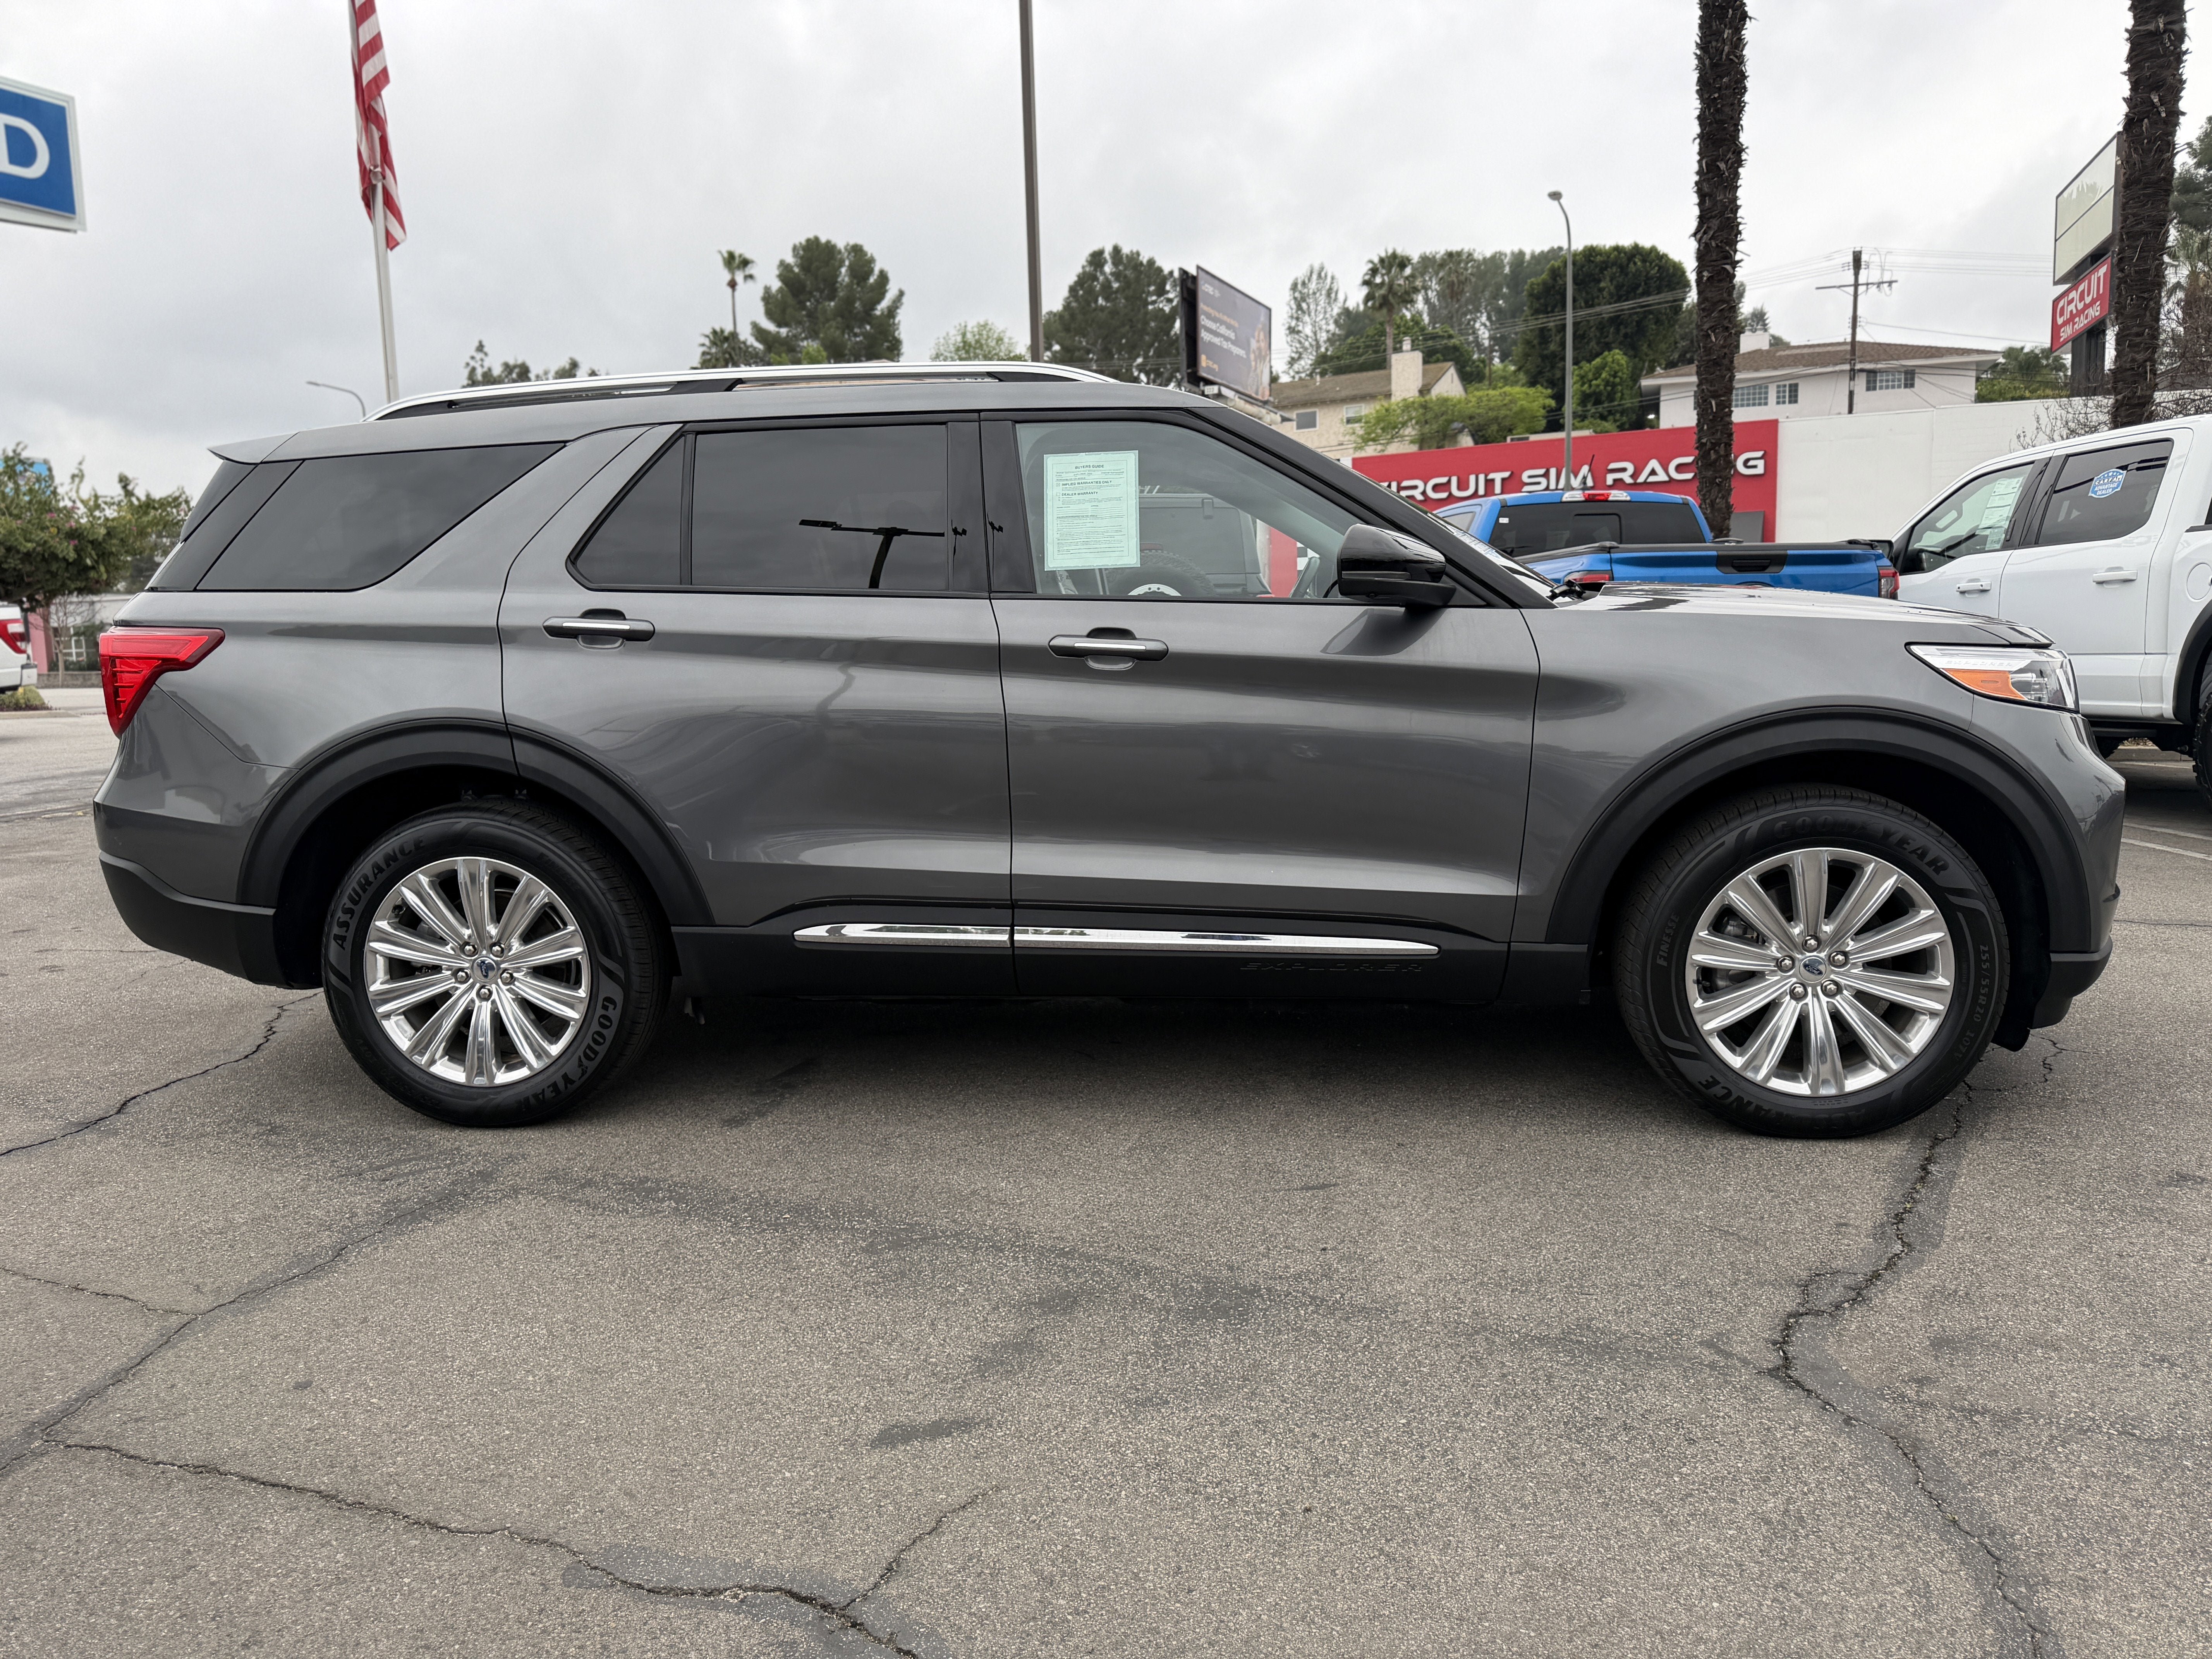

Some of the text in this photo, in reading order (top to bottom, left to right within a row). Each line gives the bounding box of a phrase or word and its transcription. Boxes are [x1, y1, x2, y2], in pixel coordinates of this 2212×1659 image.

[2057, 264, 2107, 325] CIRCUIT
[2060, 301, 2100, 342] SIM RACING
[1378, 450, 1765, 500] IRCUIT SIM RACG
[2094, 483, 2118, 491] ADVANTAGE
[2095, 475, 2123, 485] CARFAX
[333, 835, 426, 950] ASSURANCE
[1805, 965, 1821, 975] Ford
[1955, 945, 1991, 1061] 255/55R20 107V
